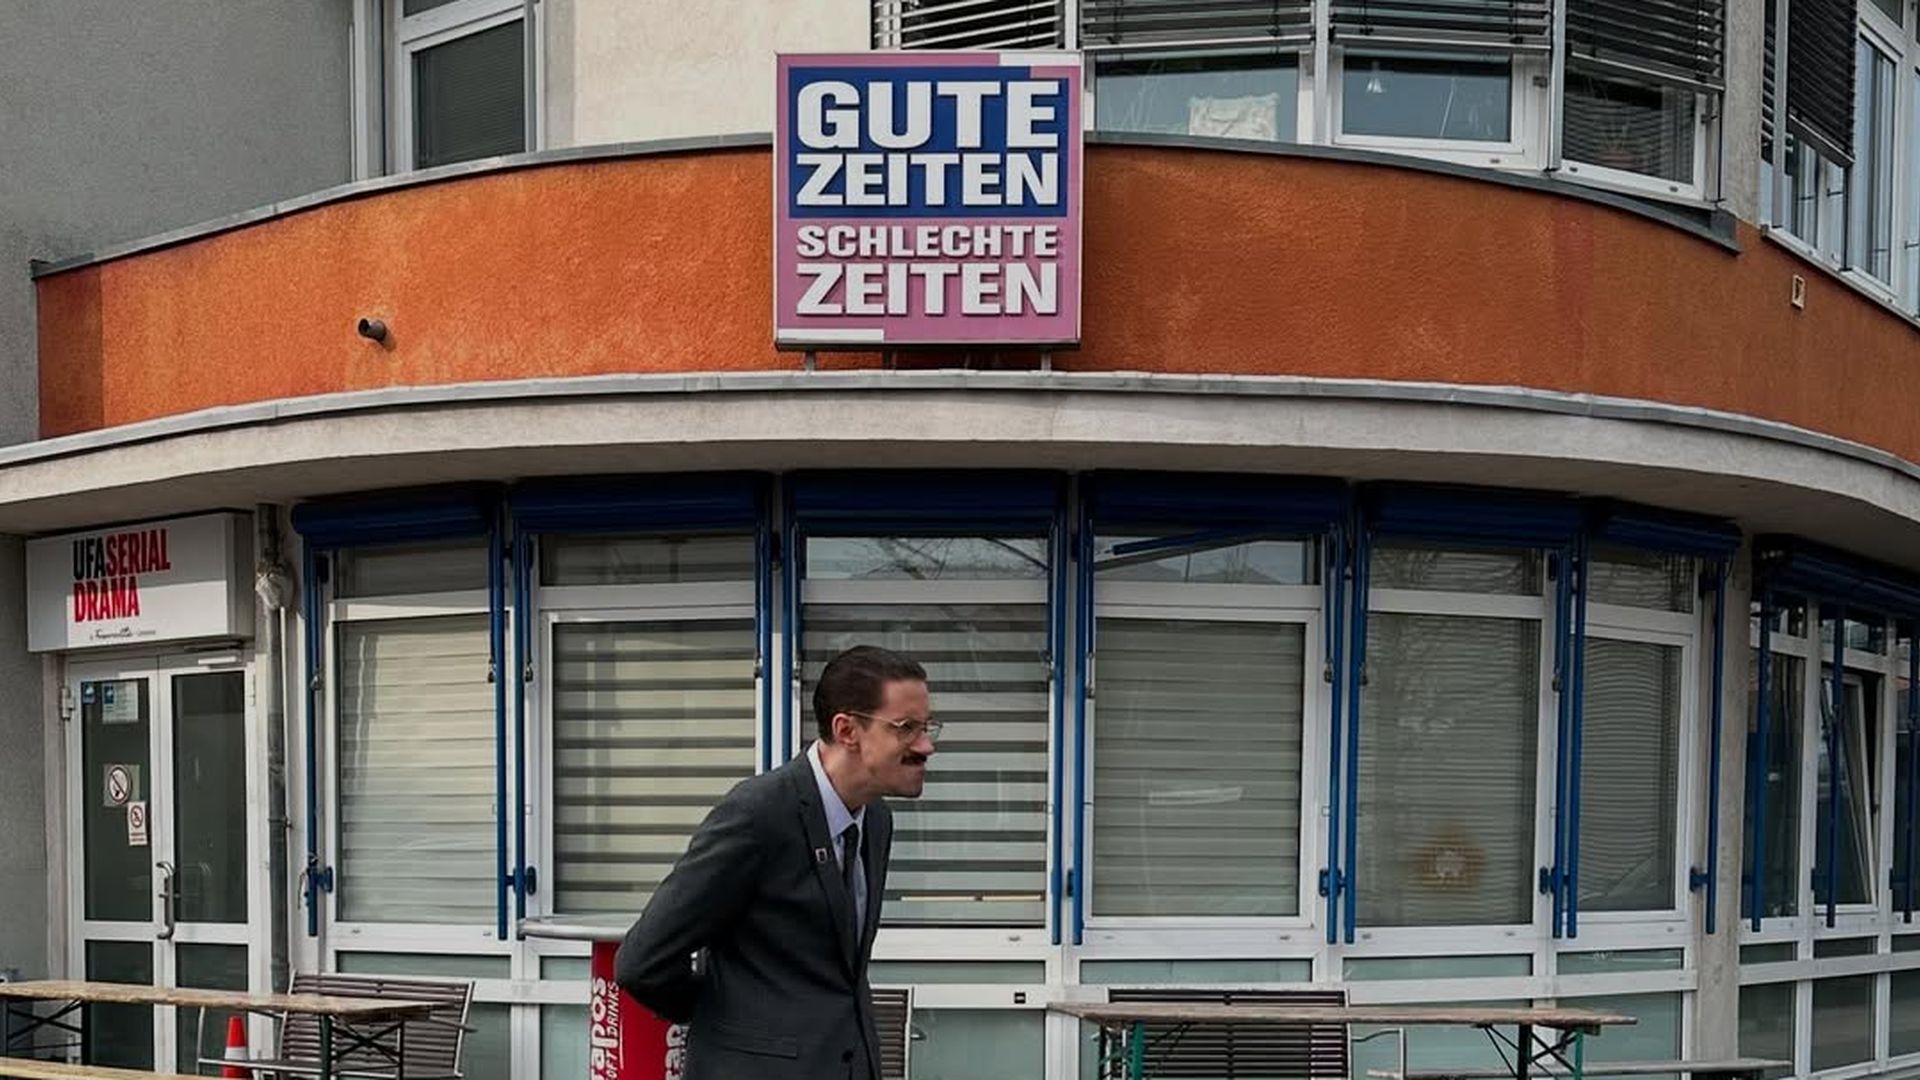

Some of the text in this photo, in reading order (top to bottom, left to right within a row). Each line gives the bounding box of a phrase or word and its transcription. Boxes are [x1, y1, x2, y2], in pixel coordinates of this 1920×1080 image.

[797, 80, 1059, 149] GUTE
[796, 153, 1058, 206] ZEITEN
[796, 225, 1057, 257] SCHLECHTE
[796, 263, 1057, 315] ZEITEN
[73, 576, 140, 623] DRAMA
[606, 981, 620, 1080] OFT DRINKS
